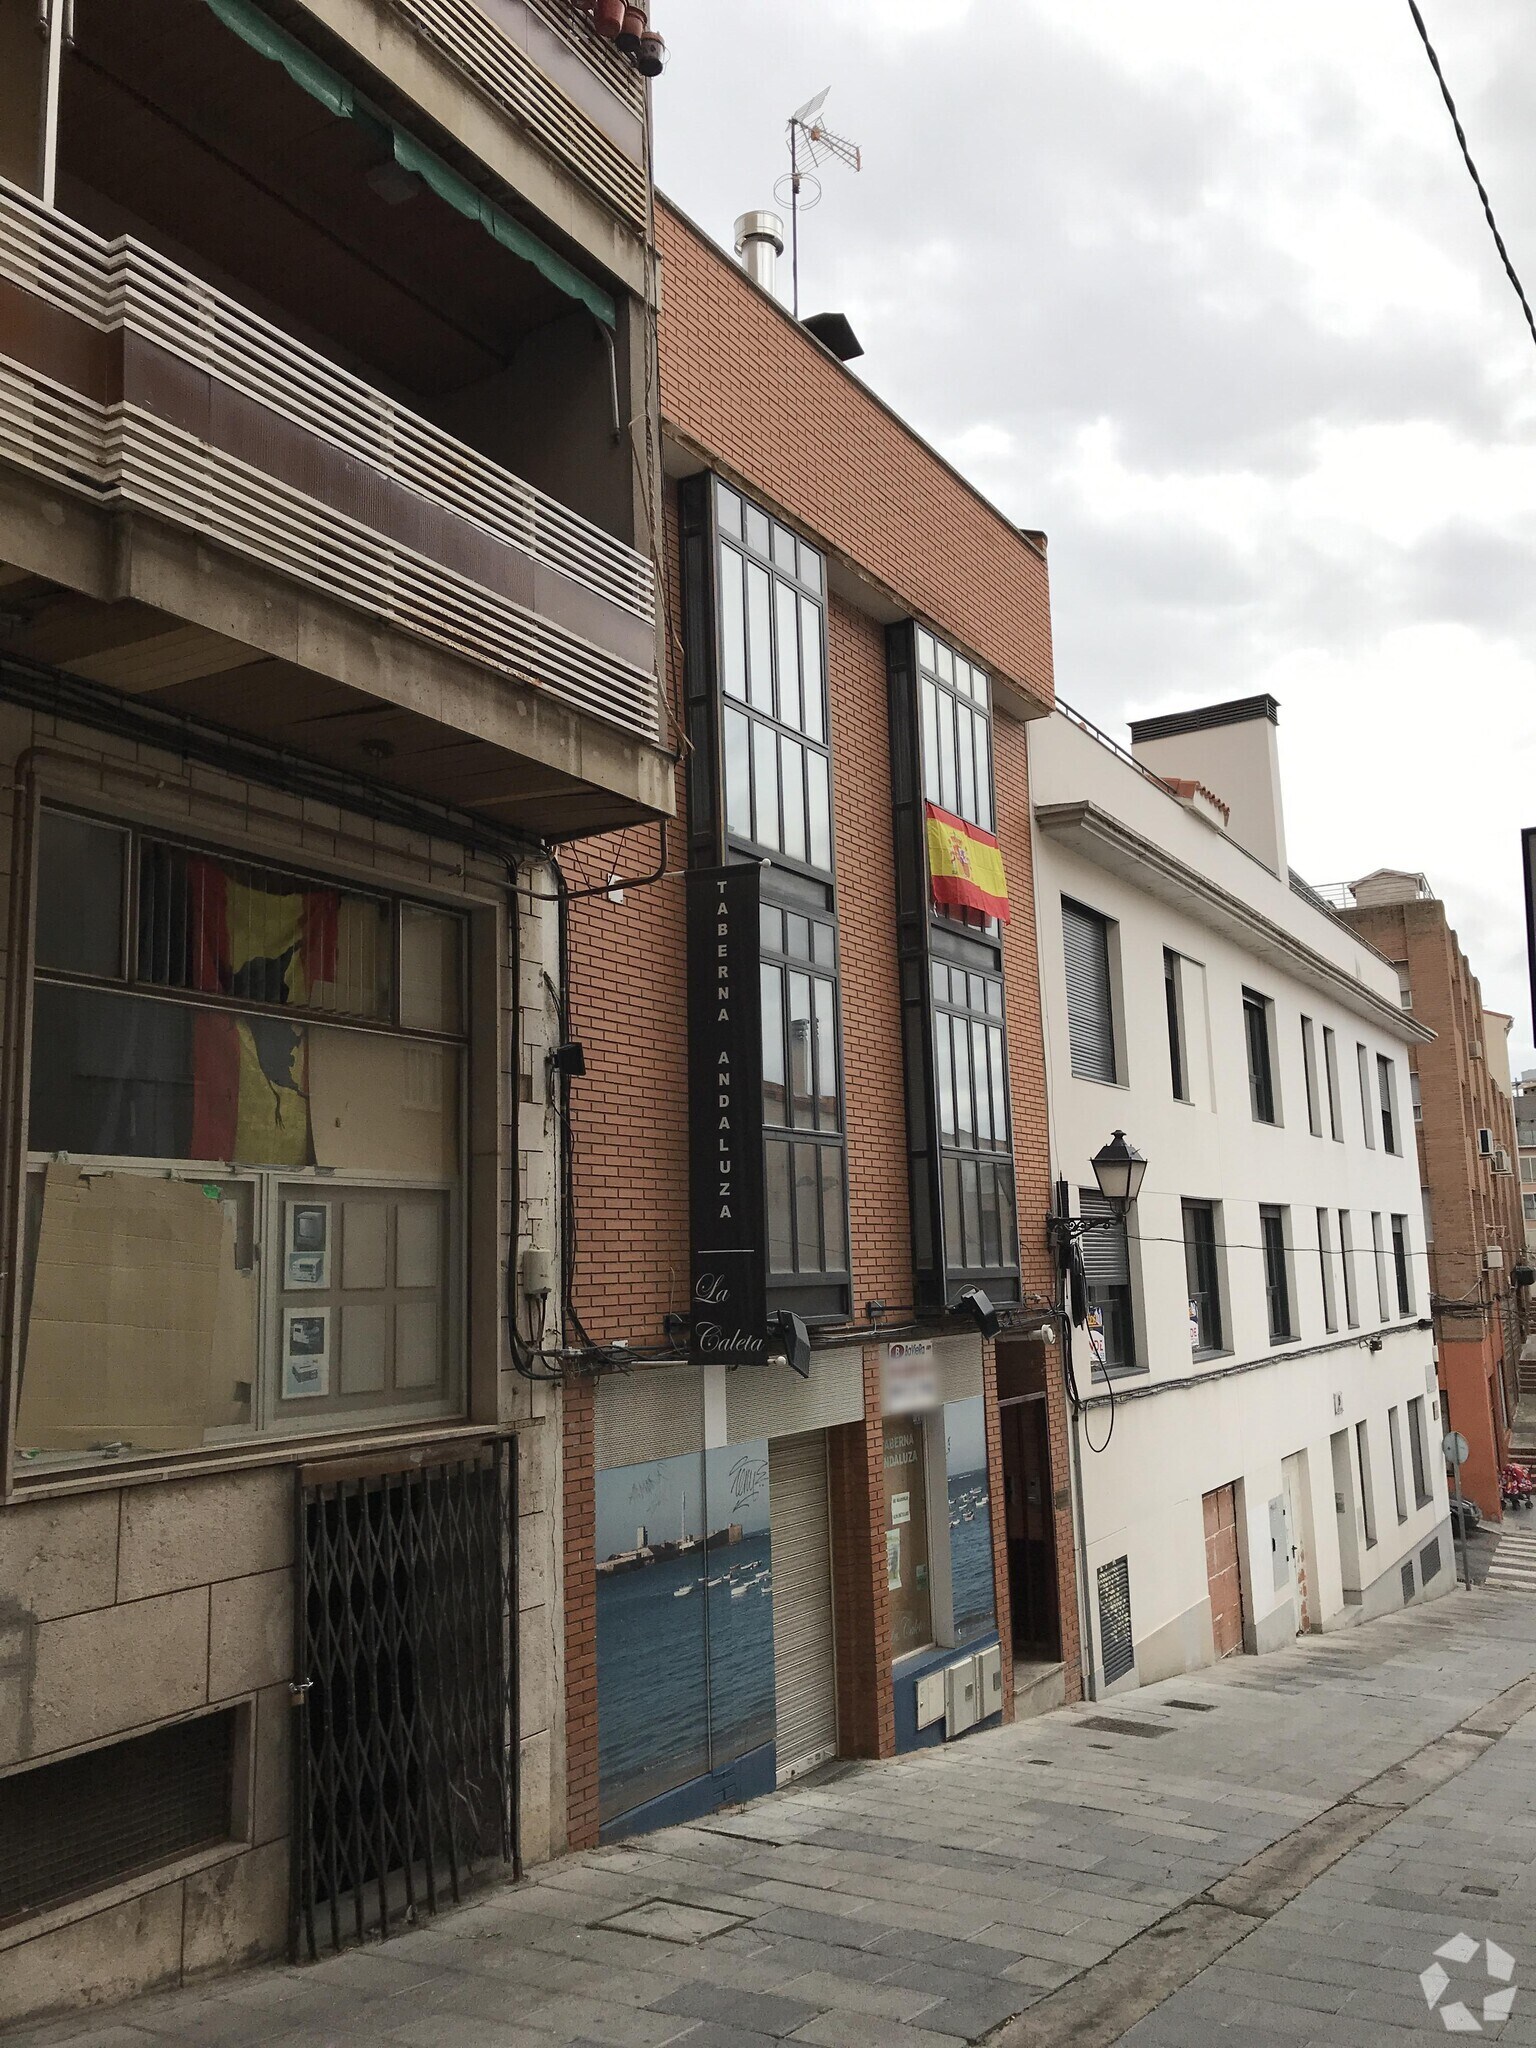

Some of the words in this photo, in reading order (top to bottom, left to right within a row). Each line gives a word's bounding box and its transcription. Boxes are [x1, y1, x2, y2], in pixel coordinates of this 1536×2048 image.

[717, 880, 729, 1021] TABERNA
[718, 1051, 731, 1218] ANDALUZA
[693, 1273, 730, 1304] La
[696, 1321, 764, 1352] Caleta
[884, 1434, 914, 1450] ABERNA
[884, 1450, 918, 1469] NDALUZA
